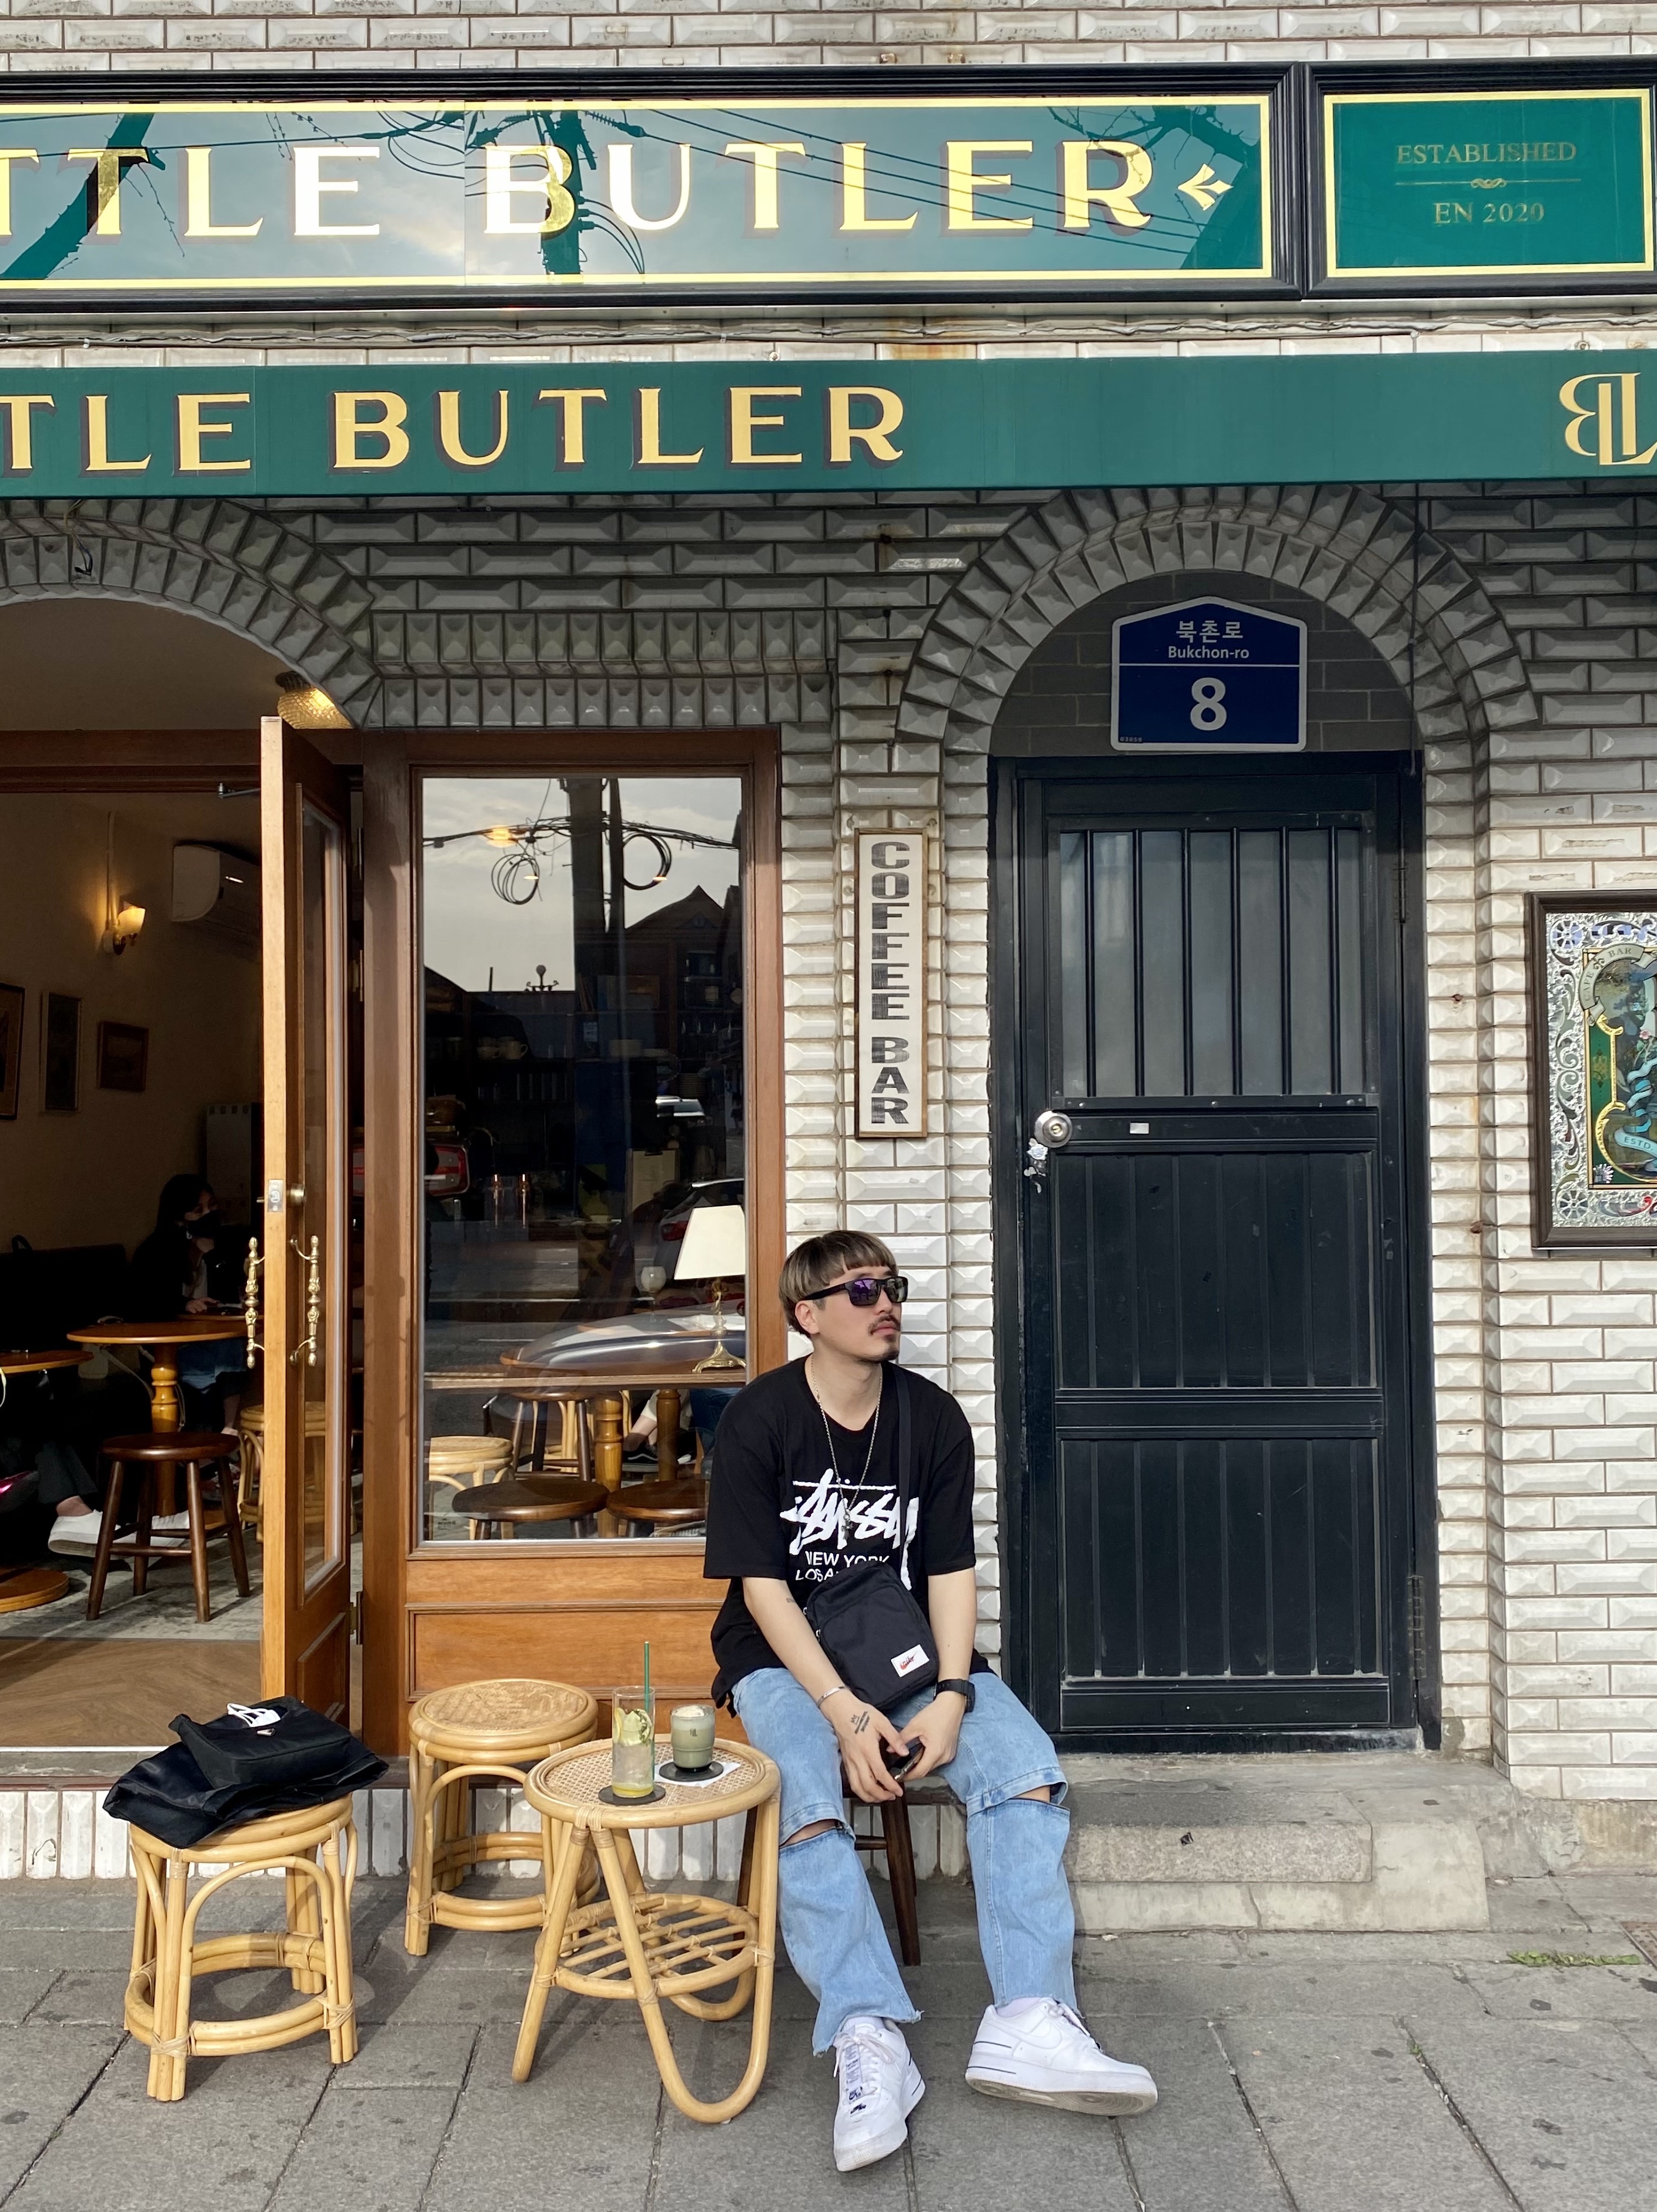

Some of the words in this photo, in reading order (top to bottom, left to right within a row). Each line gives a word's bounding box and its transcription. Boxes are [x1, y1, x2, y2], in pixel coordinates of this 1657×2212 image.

[1397, 142, 1576, 165] ESTABLISHED
[484, 140, 1153, 234] BUTLER
[1434, 202, 1473, 225] EN
[1484, 202, 1545, 223] 2020
[334, 386, 904, 469] BUTLER
[1176, 620, 1244, 643] 북촌로
[1168, 645, 1250, 659] Bukchon-ro
[1190, 677, 1227, 731] 8
[871, 841, 910, 1020] COFFEE
[1608, 947, 1633, 957] BAR
[871, 1036, 910, 1125] BAR
[1624, 1136, 1654, 1152] ESTD.
[805, 1550, 840, 1566] NEW
[795, 1568, 824, 1582] LOS
